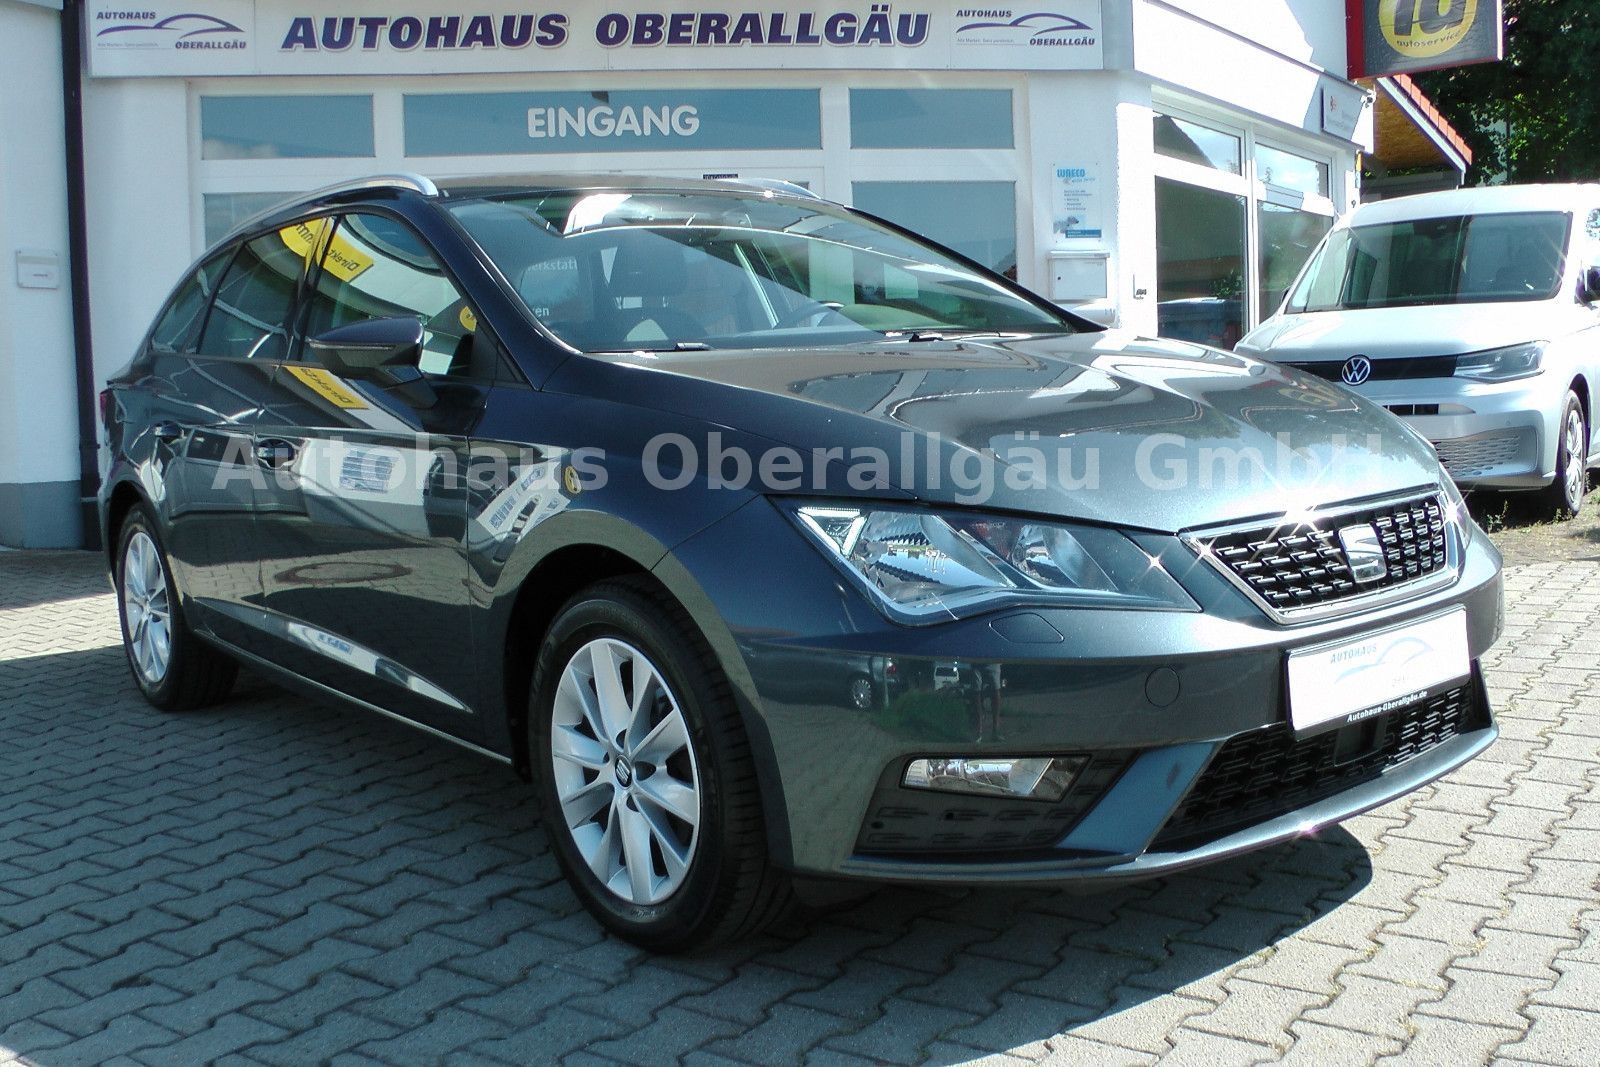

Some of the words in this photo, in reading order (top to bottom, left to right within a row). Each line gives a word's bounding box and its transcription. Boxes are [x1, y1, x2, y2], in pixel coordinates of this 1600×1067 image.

[96, 11, 156, 20] AUTOHAUS
[956, 9, 1012, 18] AUTOHAUS
[278, 13, 569, 52] AUTOHAUS
[595, 4, 931, 48] OBERALLGÄU
[175, 39, 247, 50] OBERALLGÄU
[1029, 35, 1095, 46] OBERALLGÄU
[1396, 31, 1462, 48] autoservice
[527, 105, 700, 138] EINGANG
[1330, 645, 1377, 664] AUTOHAUS
